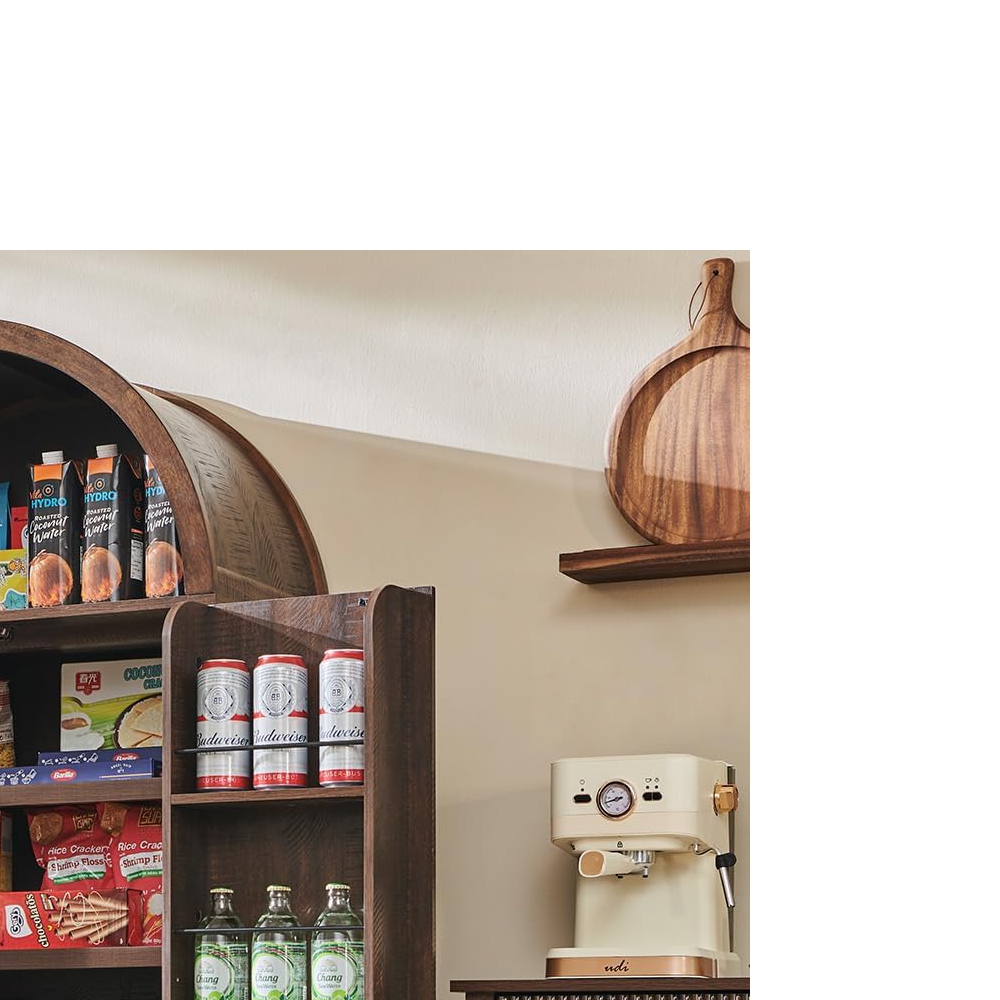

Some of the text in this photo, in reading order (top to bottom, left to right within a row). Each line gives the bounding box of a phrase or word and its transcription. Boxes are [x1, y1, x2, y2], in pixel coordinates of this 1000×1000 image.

[84, 490, 118, 503] HYDRO
[145, 487, 164, 497] HYD
[31, 497, 67, 509] HYDRO
[34, 513, 62, 521] ROASTED
[86, 507, 111, 516] ROASTED
[29, 515, 69, 535] Coconut
[83, 509, 119, 529] Coconut
[33, 527, 65, 543] Water
[84, 521, 115, 537] Water
[124, 664, 162, 681] COCON
[254, 729, 307, 743] Budweiser
[320, 725, 364, 738] udweise
[197, 733, 248, 747] Budweiser
[117, 841, 137, 851] Rice
[81, 857, 105, 867] Floss
[122, 856, 151, 869] Shrimp
[196, 974, 219, 985] Chang
[256, 974, 279, 984] Chang
[317, 973, 343, 984] Chang
